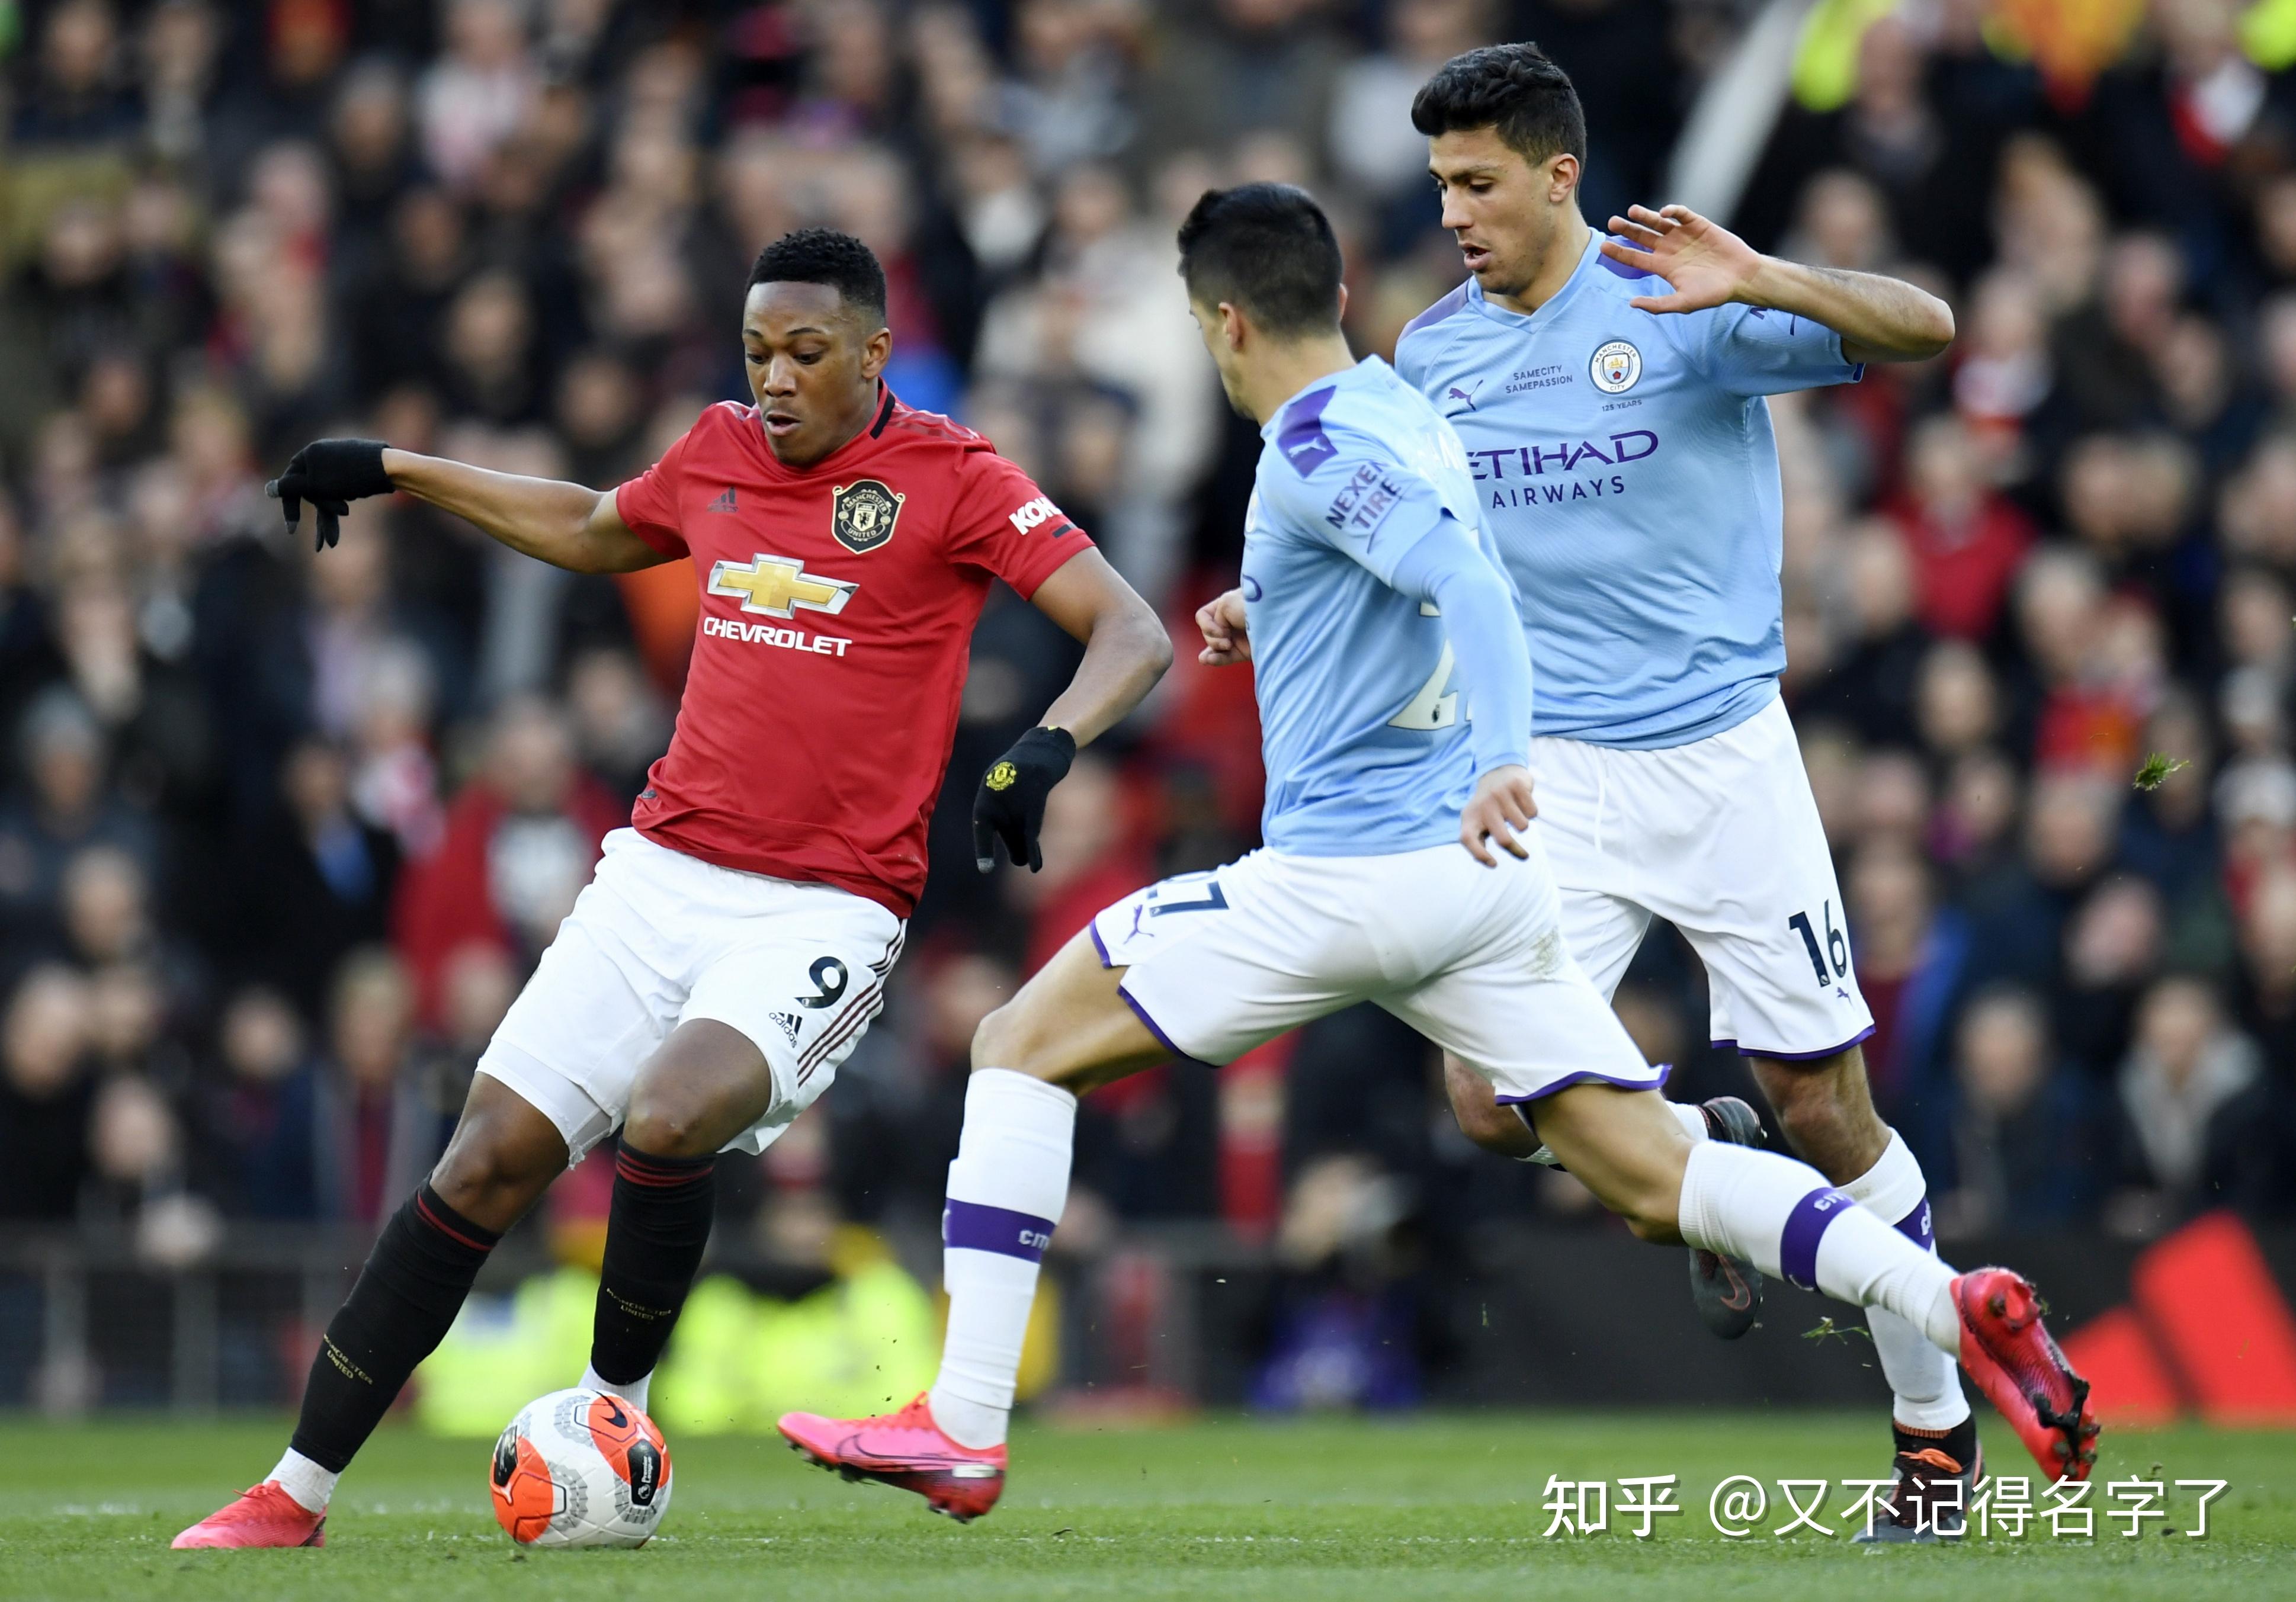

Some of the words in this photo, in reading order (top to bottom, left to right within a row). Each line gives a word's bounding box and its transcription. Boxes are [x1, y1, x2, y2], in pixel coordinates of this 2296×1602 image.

[1595, 344, 1637, 363] MANCHESTER
[1505, 375, 1573, 393] SAMEPASSION
[1513, 365, 1562, 380] SAMECITY
[1617, 400, 1643, 409] YEARS
[846, 493, 887, 512] MANCHESTER
[1351, 477, 1402, 529] TIRE
[1492, 476, 1624, 509] AIRWAYS
[848, 528, 877, 538] UNITED
[703, 617, 853, 657] CHEVROLET
[1788, 899, 1847, 987] 16
[794, 956, 848, 1009] 9
[769, 1012, 797, 1048] adidas
